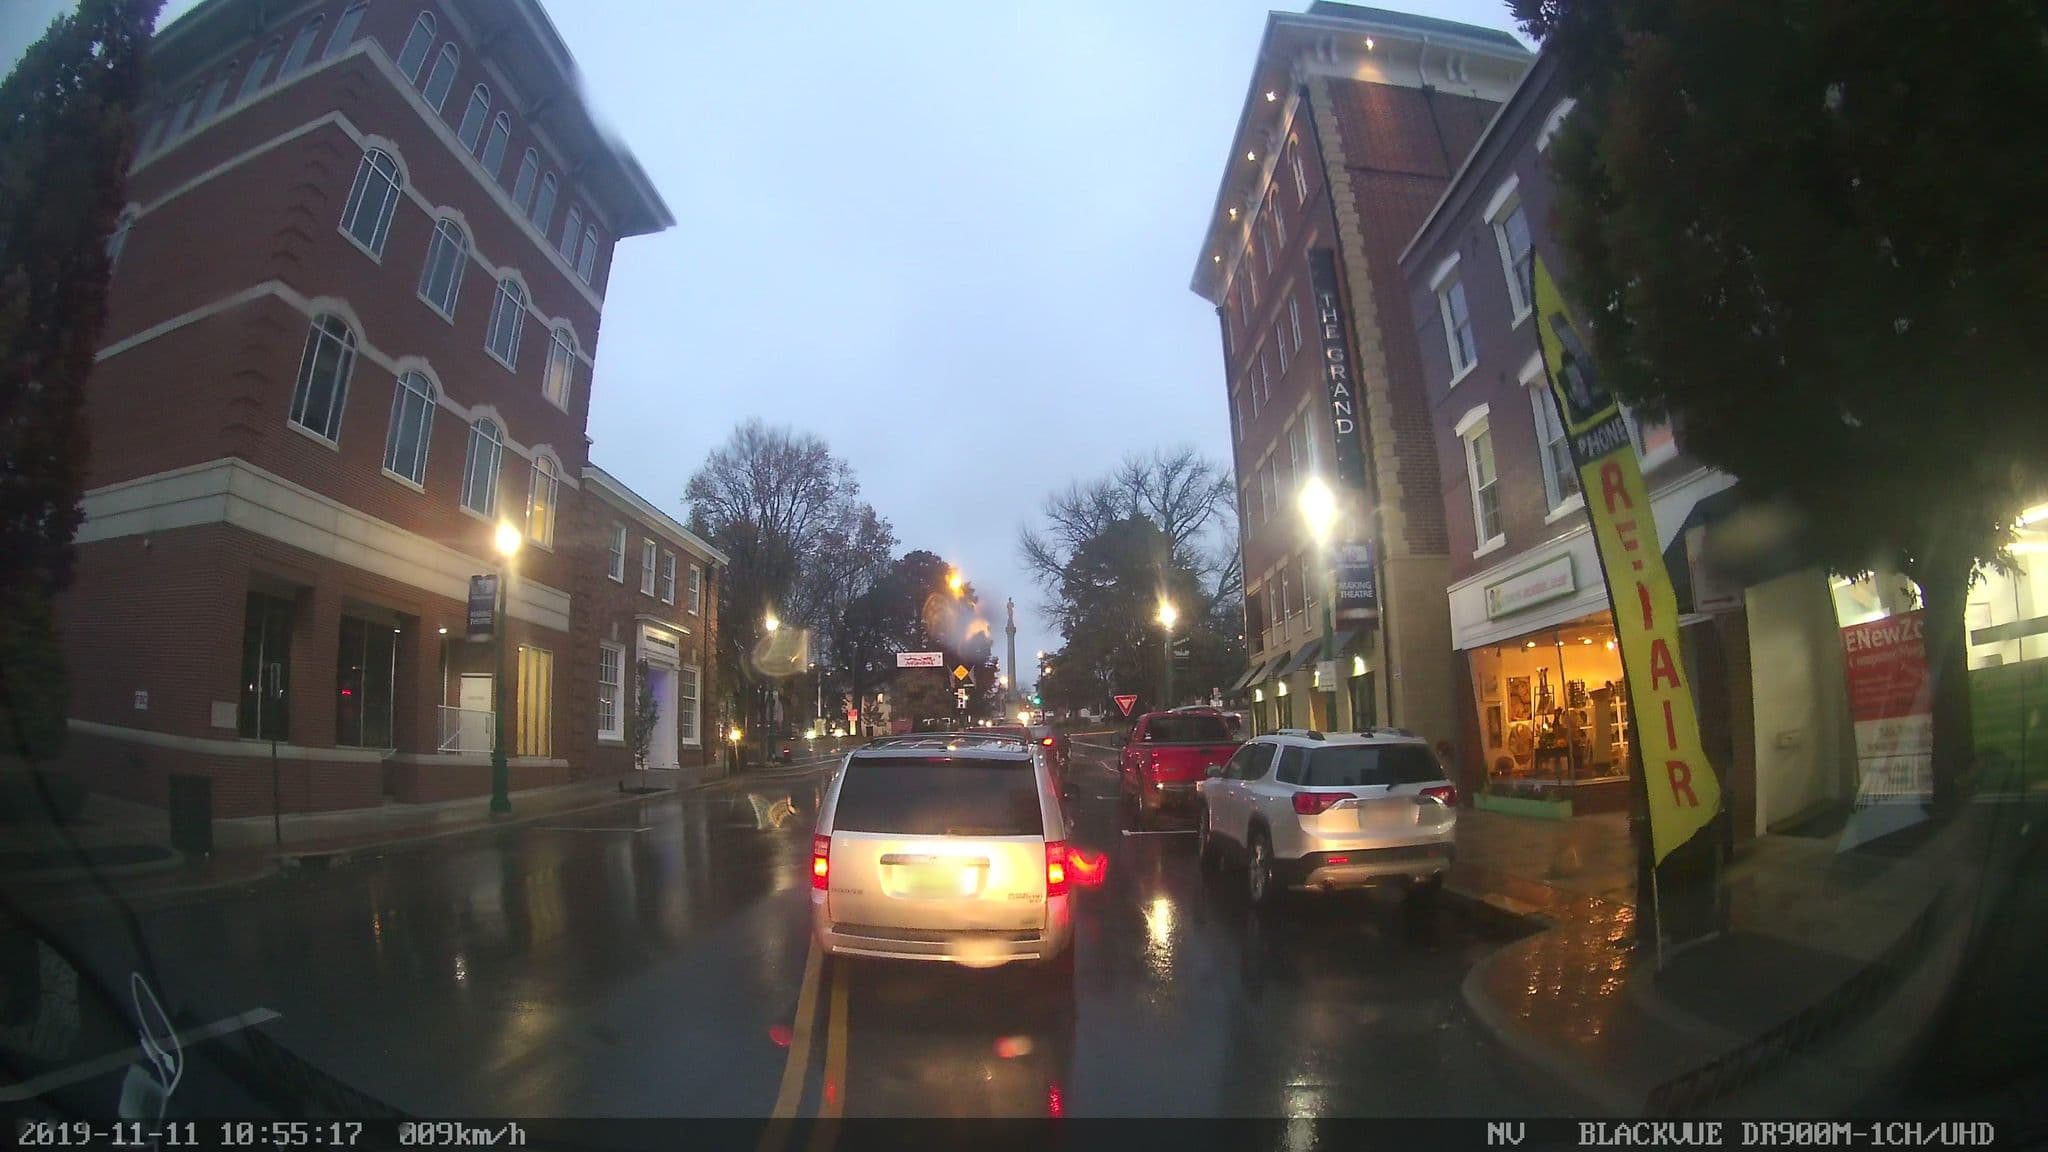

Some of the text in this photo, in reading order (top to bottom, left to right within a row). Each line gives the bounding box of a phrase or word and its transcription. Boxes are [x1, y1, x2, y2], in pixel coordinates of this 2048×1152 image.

[1320, 292, 1354, 434] THE GRAND
[1340, 590, 1374, 599] THEATRE
